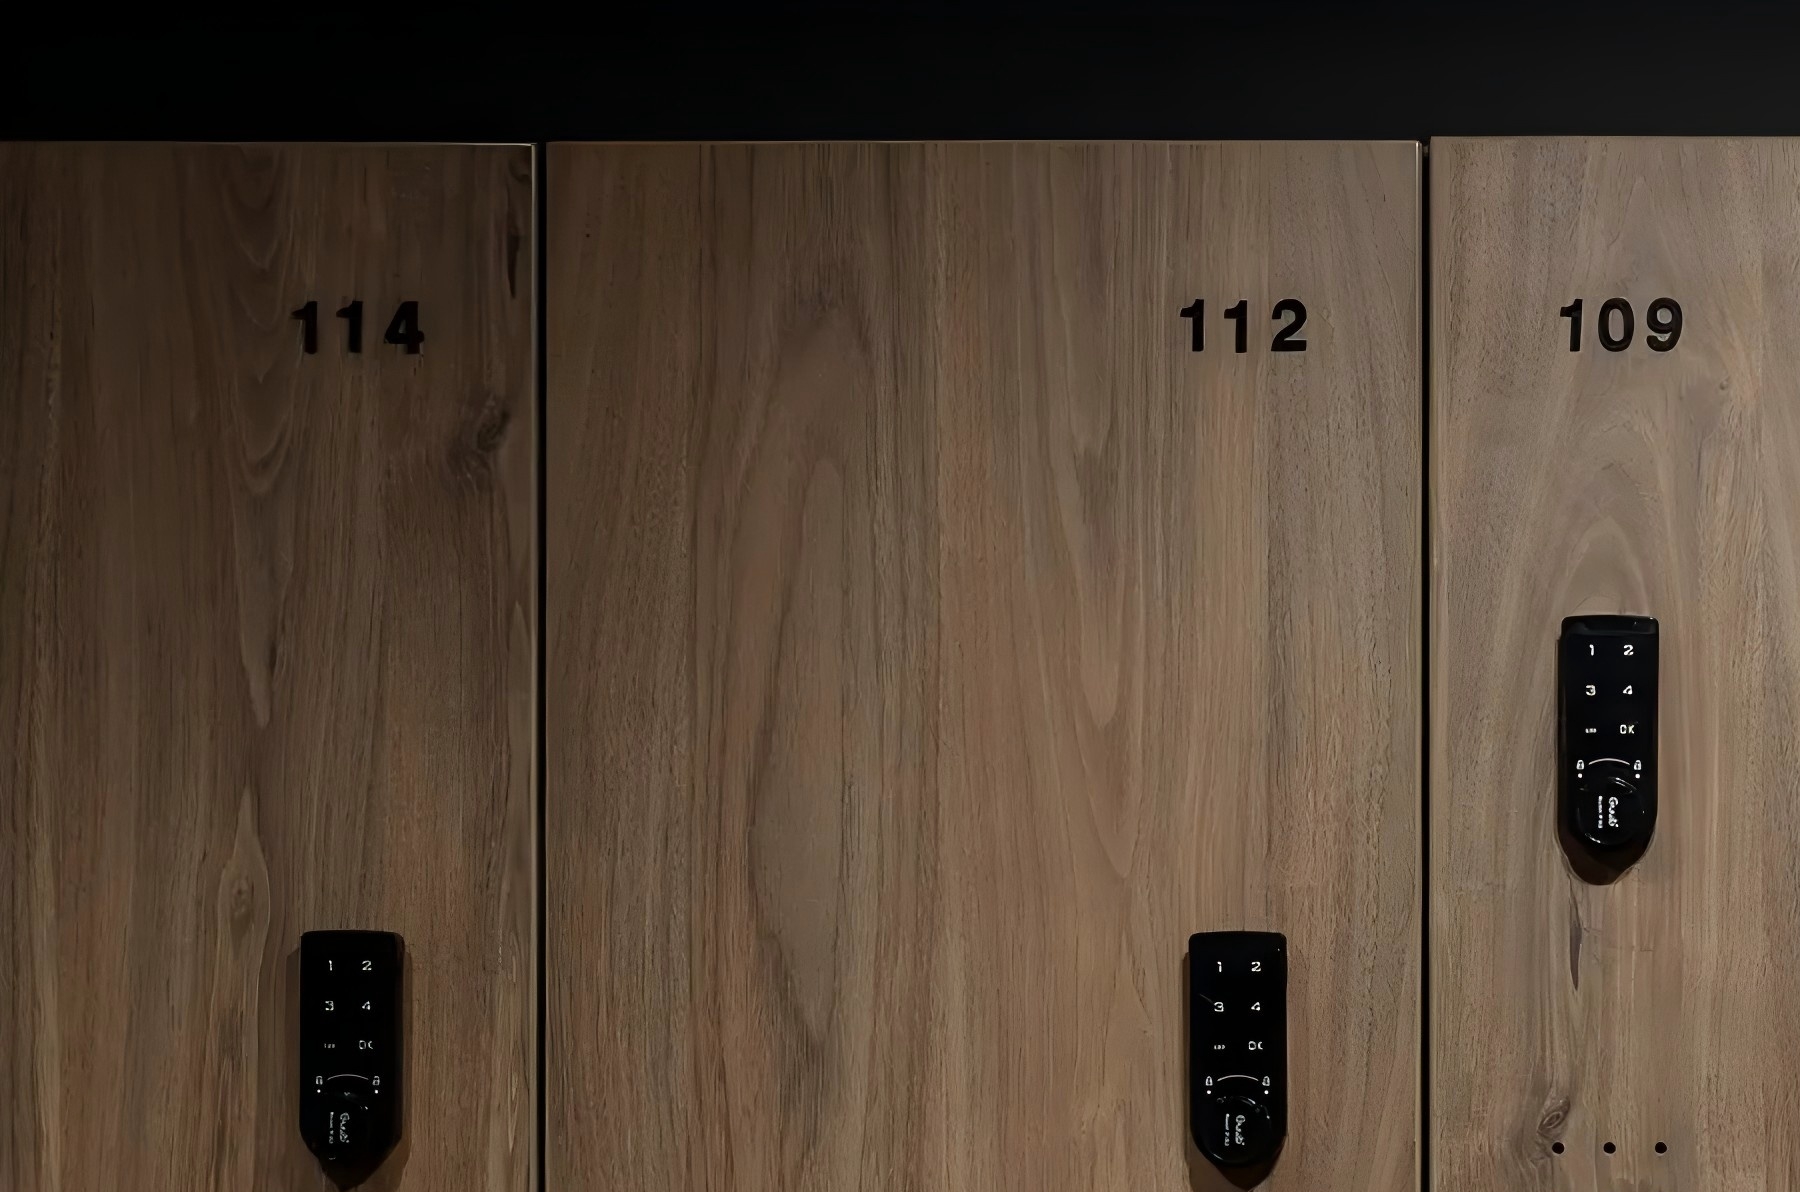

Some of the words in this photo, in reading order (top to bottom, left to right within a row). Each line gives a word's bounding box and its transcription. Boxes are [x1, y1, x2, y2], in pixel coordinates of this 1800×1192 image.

[288, 299, 426, 357] 114
[1179, 298, 1307, 354] 112
[1559, 297, 1683, 353] 109
[1589, 644, 1595, 656] 1
[1623, 644, 1635, 656] 2
[1585, 684, 1597, 696] 3
[328, 960, 333, 971] 1
[361, 960, 372, 971] 2
[1217, 961, 1223, 973] 1
[1250, 961, 1262, 972] 2
[324, 1000, 335, 1011] 3
[1213, 1001, 1225, 1013] 3
